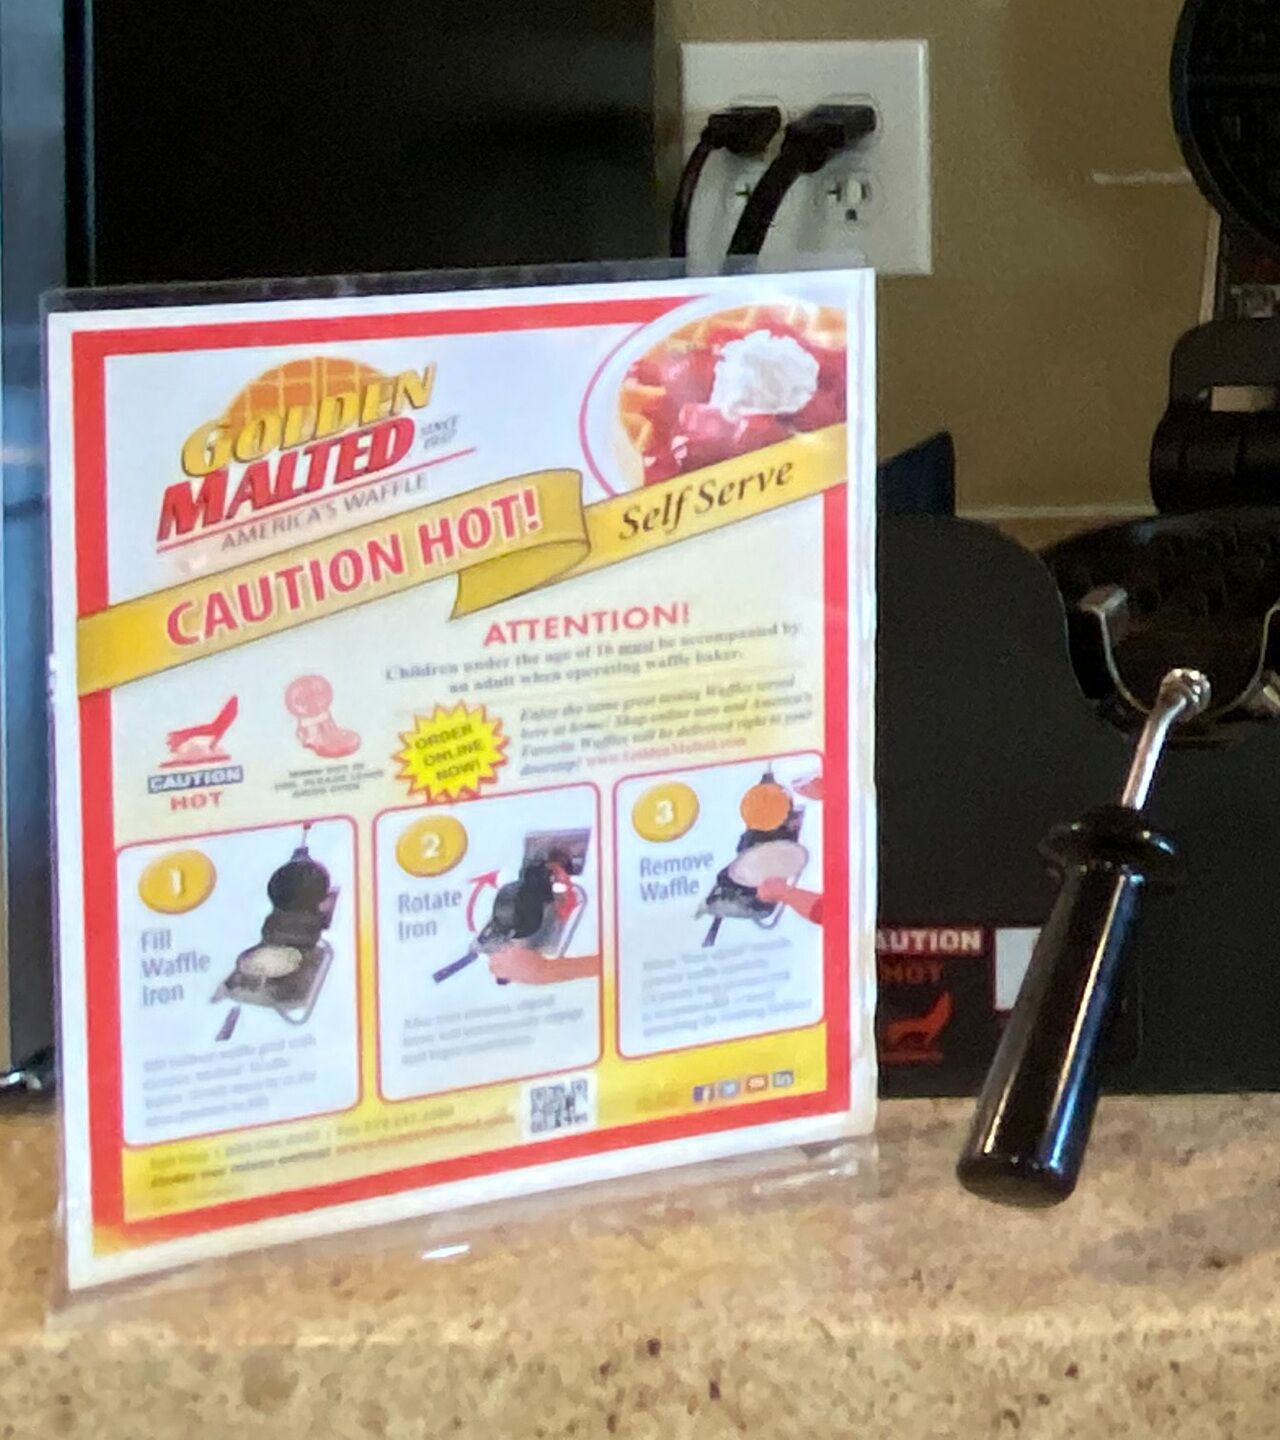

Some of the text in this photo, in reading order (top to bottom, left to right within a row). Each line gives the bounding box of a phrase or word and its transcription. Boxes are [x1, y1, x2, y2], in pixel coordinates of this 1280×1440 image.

[181, 361, 437, 478] GOLDEN
[156, 416, 416, 542] MALTED
[220, 473, 427, 552] AMERICA'S WAFFLE
[618, 460, 794, 541] Self Serve
[166, 489, 541, 647] CAUTION HOT!
[482, 602, 691, 648] ATTENTION!
[150, 766, 241, 794] CAUTION
[170, 790, 223, 811] HOT
[654, 799, 676, 826] 3
[420, 831, 441, 860] 2
[640, 850, 714, 878] Remove
[170, 866, 183, 897] 1
[640, 877, 701, 903] Waffle
[398, 889, 463, 914] Rotate
[141, 927, 172, 952] Fill
[398, 919, 437, 942] Iron
[876, 927, 982, 952] AUTION
[141, 950, 211, 979] Waffle
[142, 983, 184, 1007] Iron
